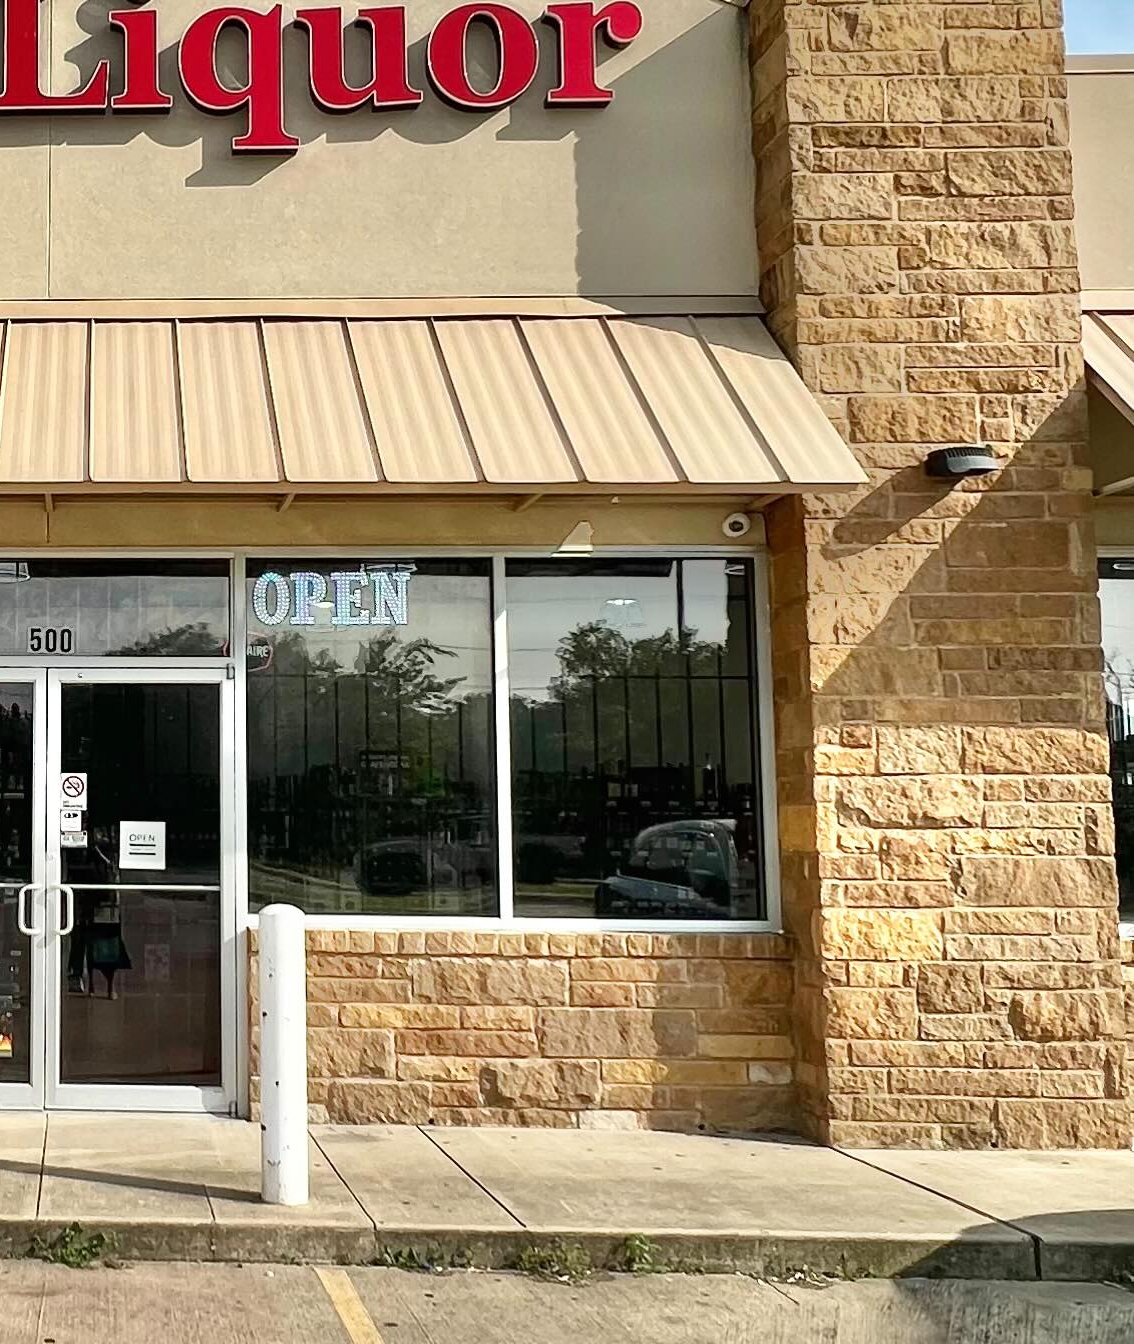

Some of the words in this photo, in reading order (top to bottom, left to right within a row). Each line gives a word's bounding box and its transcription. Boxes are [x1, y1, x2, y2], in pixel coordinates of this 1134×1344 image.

[253, 572, 411, 625] OPEN
[31, 628, 72, 652] 500
[129, 834, 155, 842] OPEN
